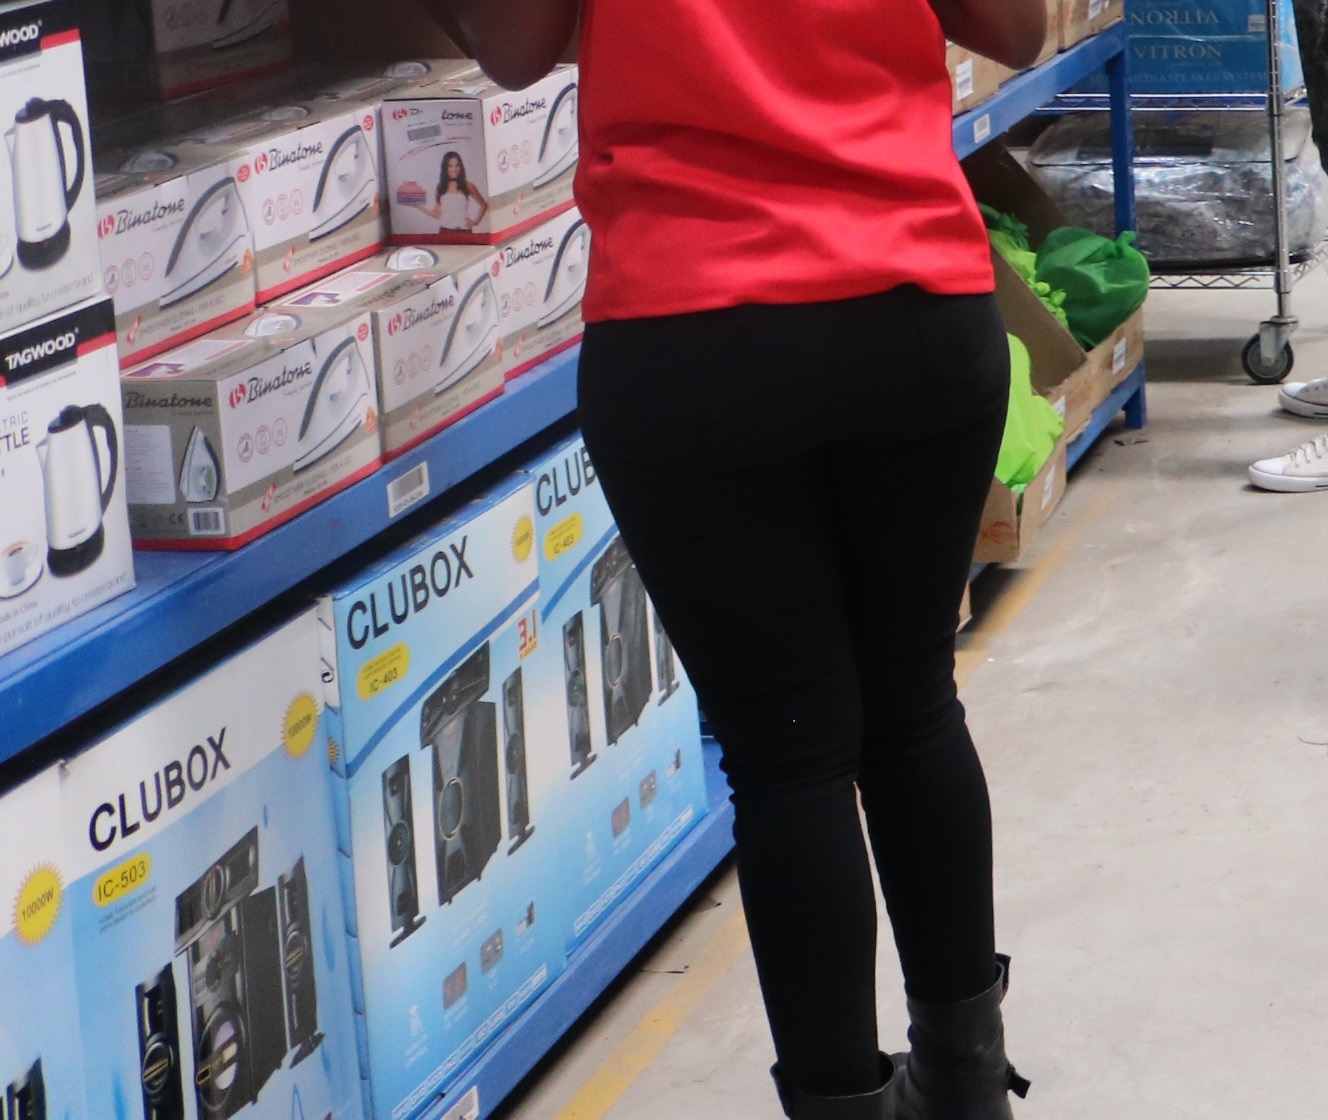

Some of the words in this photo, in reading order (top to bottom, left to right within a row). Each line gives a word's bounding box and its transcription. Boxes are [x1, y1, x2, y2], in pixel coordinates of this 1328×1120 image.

[1130, 9, 1219, 25] VITRON
[1132, 43, 1223, 59] VITRON
[502, 96, 547, 124] Binatone
[268, 140, 323, 171] Binatone
[115, 198, 185, 235] Binatone
[505, 236, 554, 268] Binatone
[402, 294, 455, 331] Binatone
[5, 333, 76, 370] TAGWOOD
[126, 392, 214, 409] Binatone
[247, 361, 312, 404] Binatone
[536, 445, 597, 517] CLUB
[346, 534, 475, 650] CLUBOX
[88, 726, 232, 853] CLUBOX
[97, 862, 146, 902] IC-503
[21, 887, 55, 923] 10000W
